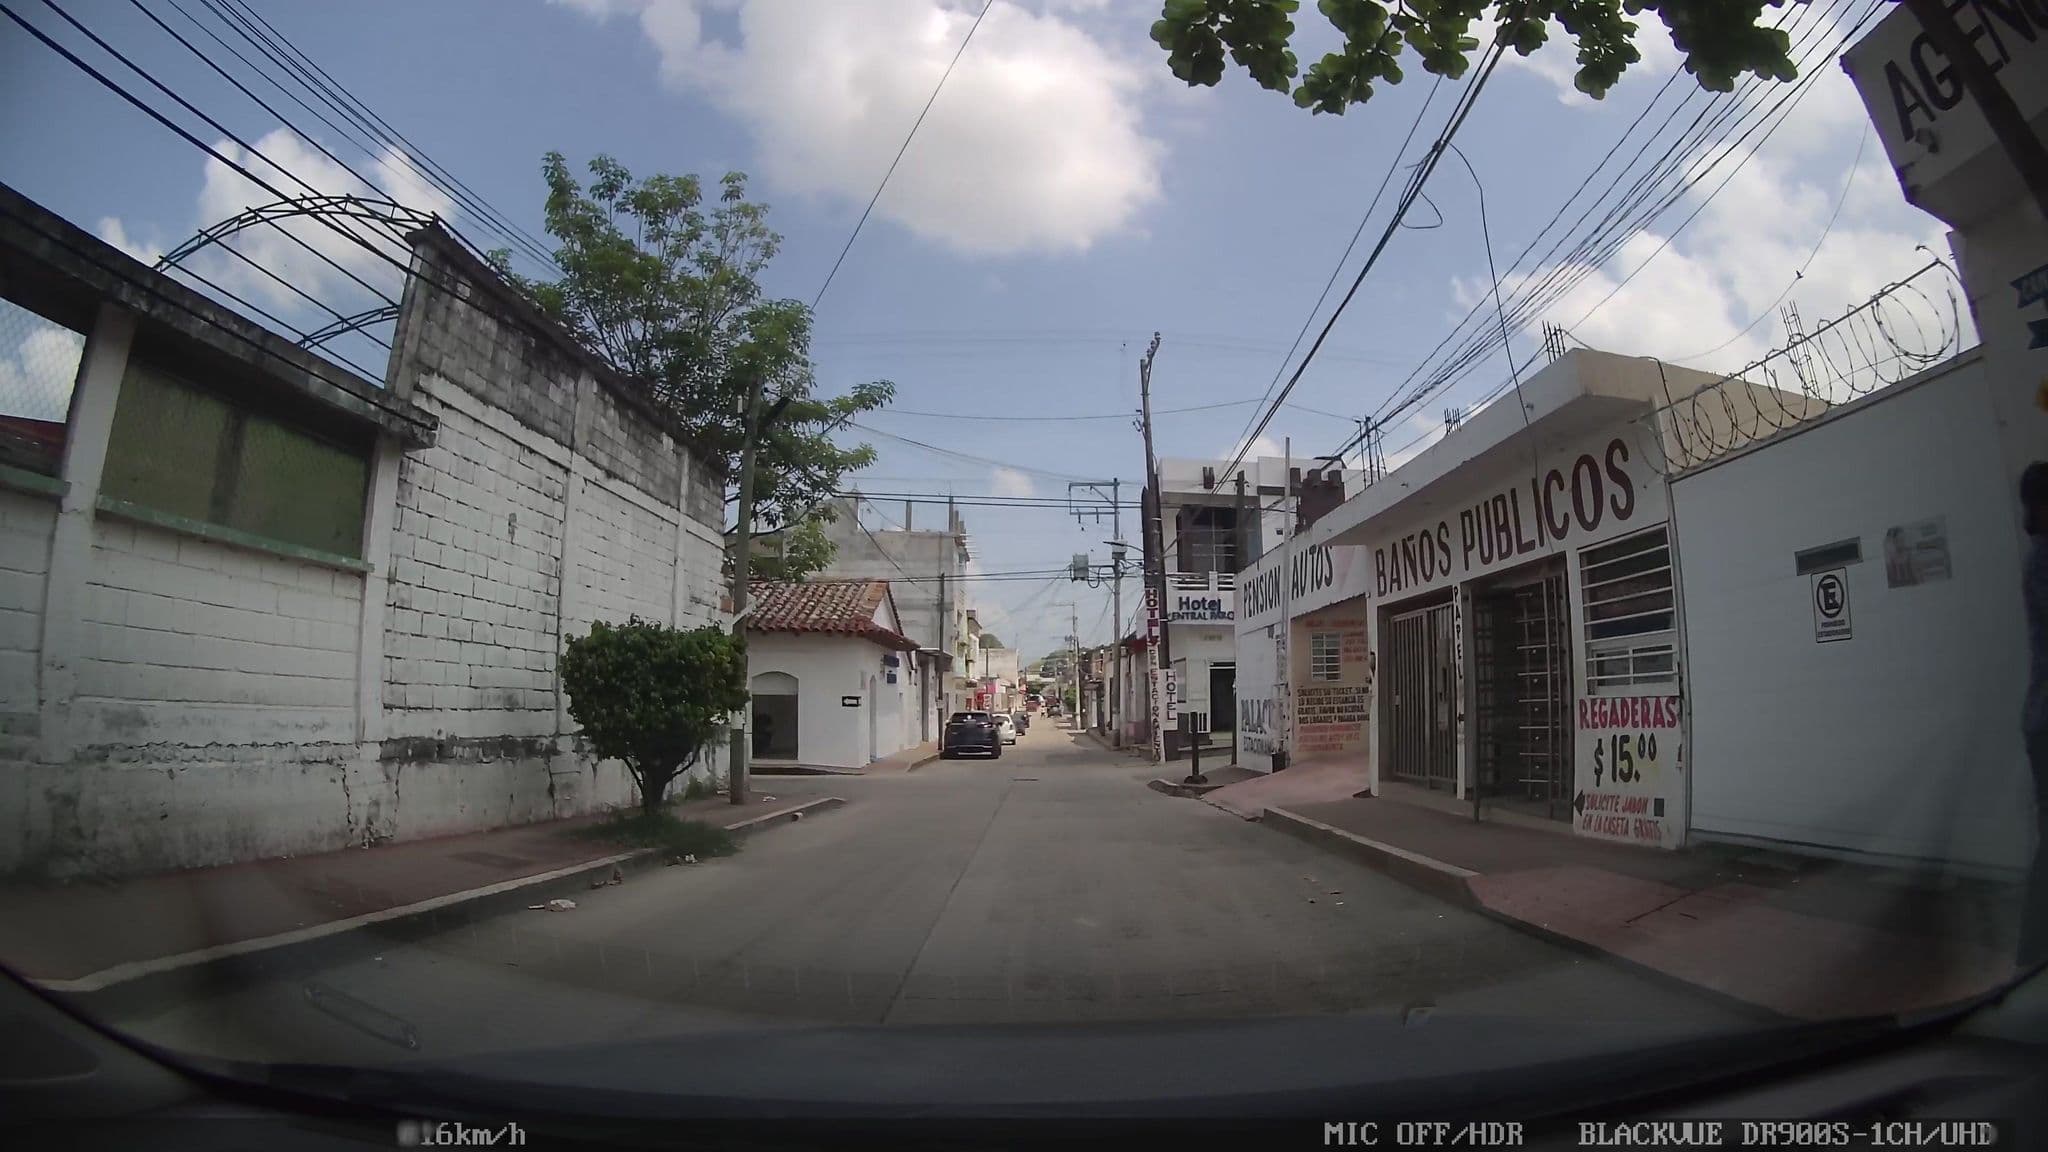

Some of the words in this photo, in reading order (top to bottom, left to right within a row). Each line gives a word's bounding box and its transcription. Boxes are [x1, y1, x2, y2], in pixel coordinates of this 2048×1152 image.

[1375, 520, 1451, 597] BAÑOS
[1460, 438, 1635, 571] PUBLICOS
[1178, 595, 1222, 612] Hotel
[1243, 564, 1281, 620] PENSION
[1291, 543, 1333, 601] AUTOS
[1165, 671, 1177, 721] HOTEL
[1579, 696, 1677, 730] REGADERAS
